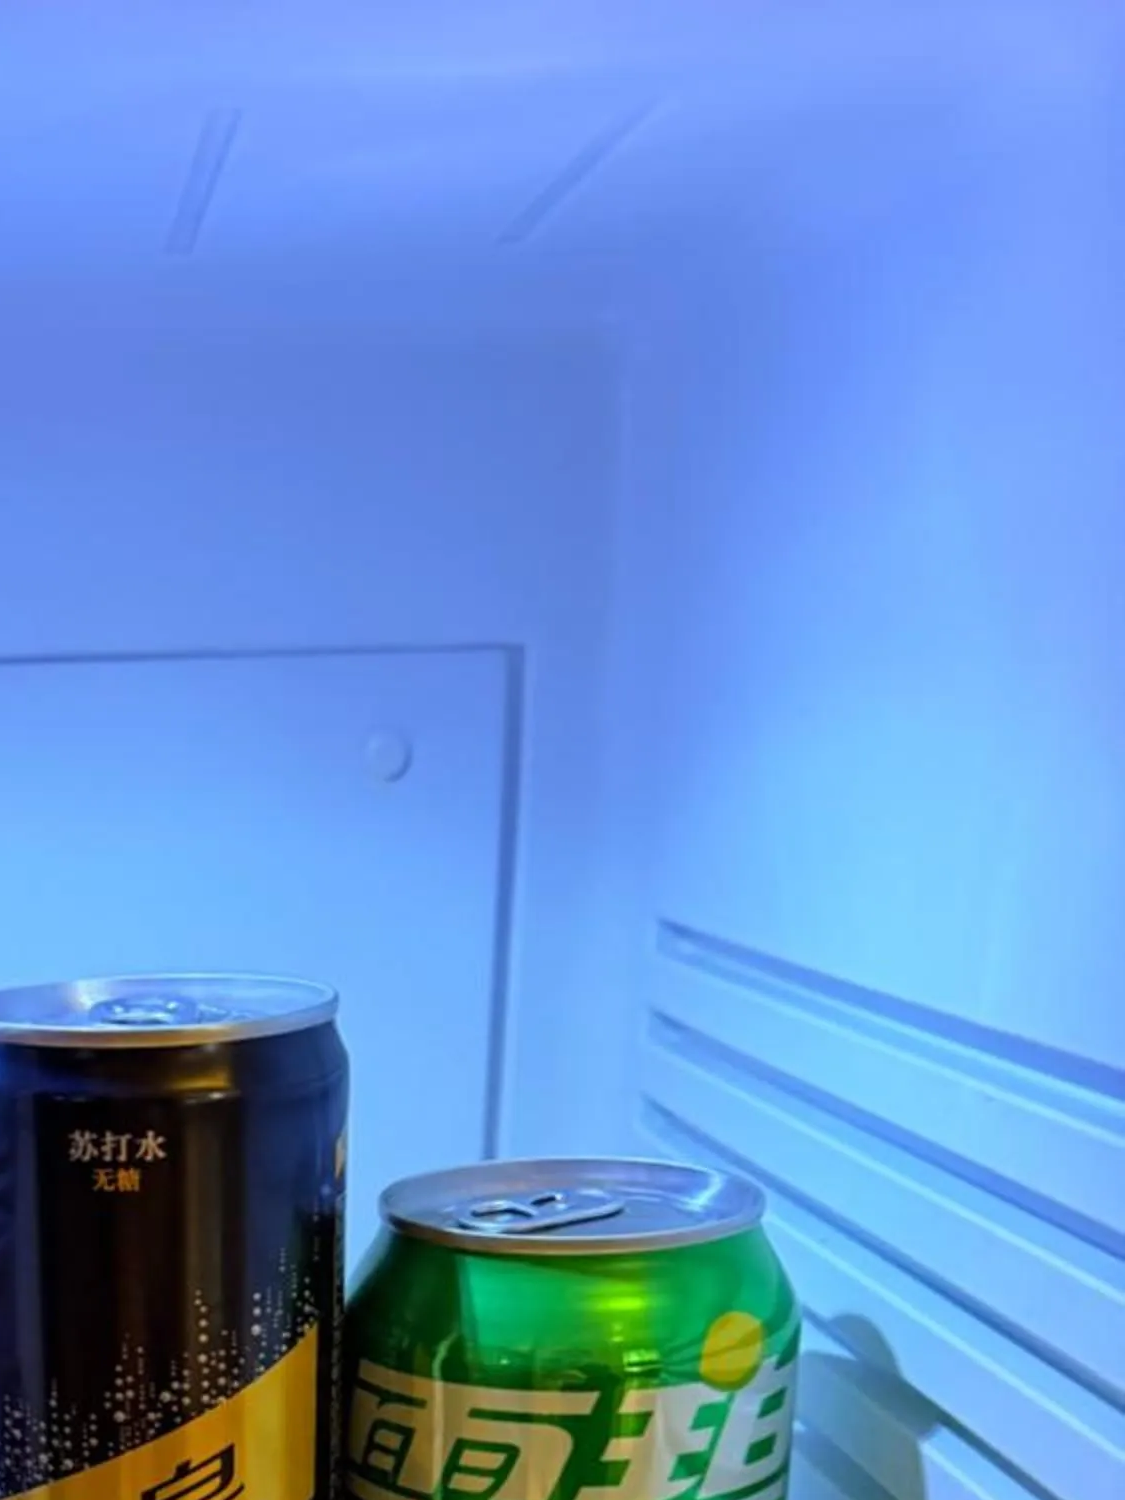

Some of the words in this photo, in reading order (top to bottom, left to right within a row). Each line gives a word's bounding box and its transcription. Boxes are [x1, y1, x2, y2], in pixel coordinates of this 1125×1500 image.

[68, 1130, 167, 1163] 苏打水
[92, 1168, 141, 1192] 无糖
